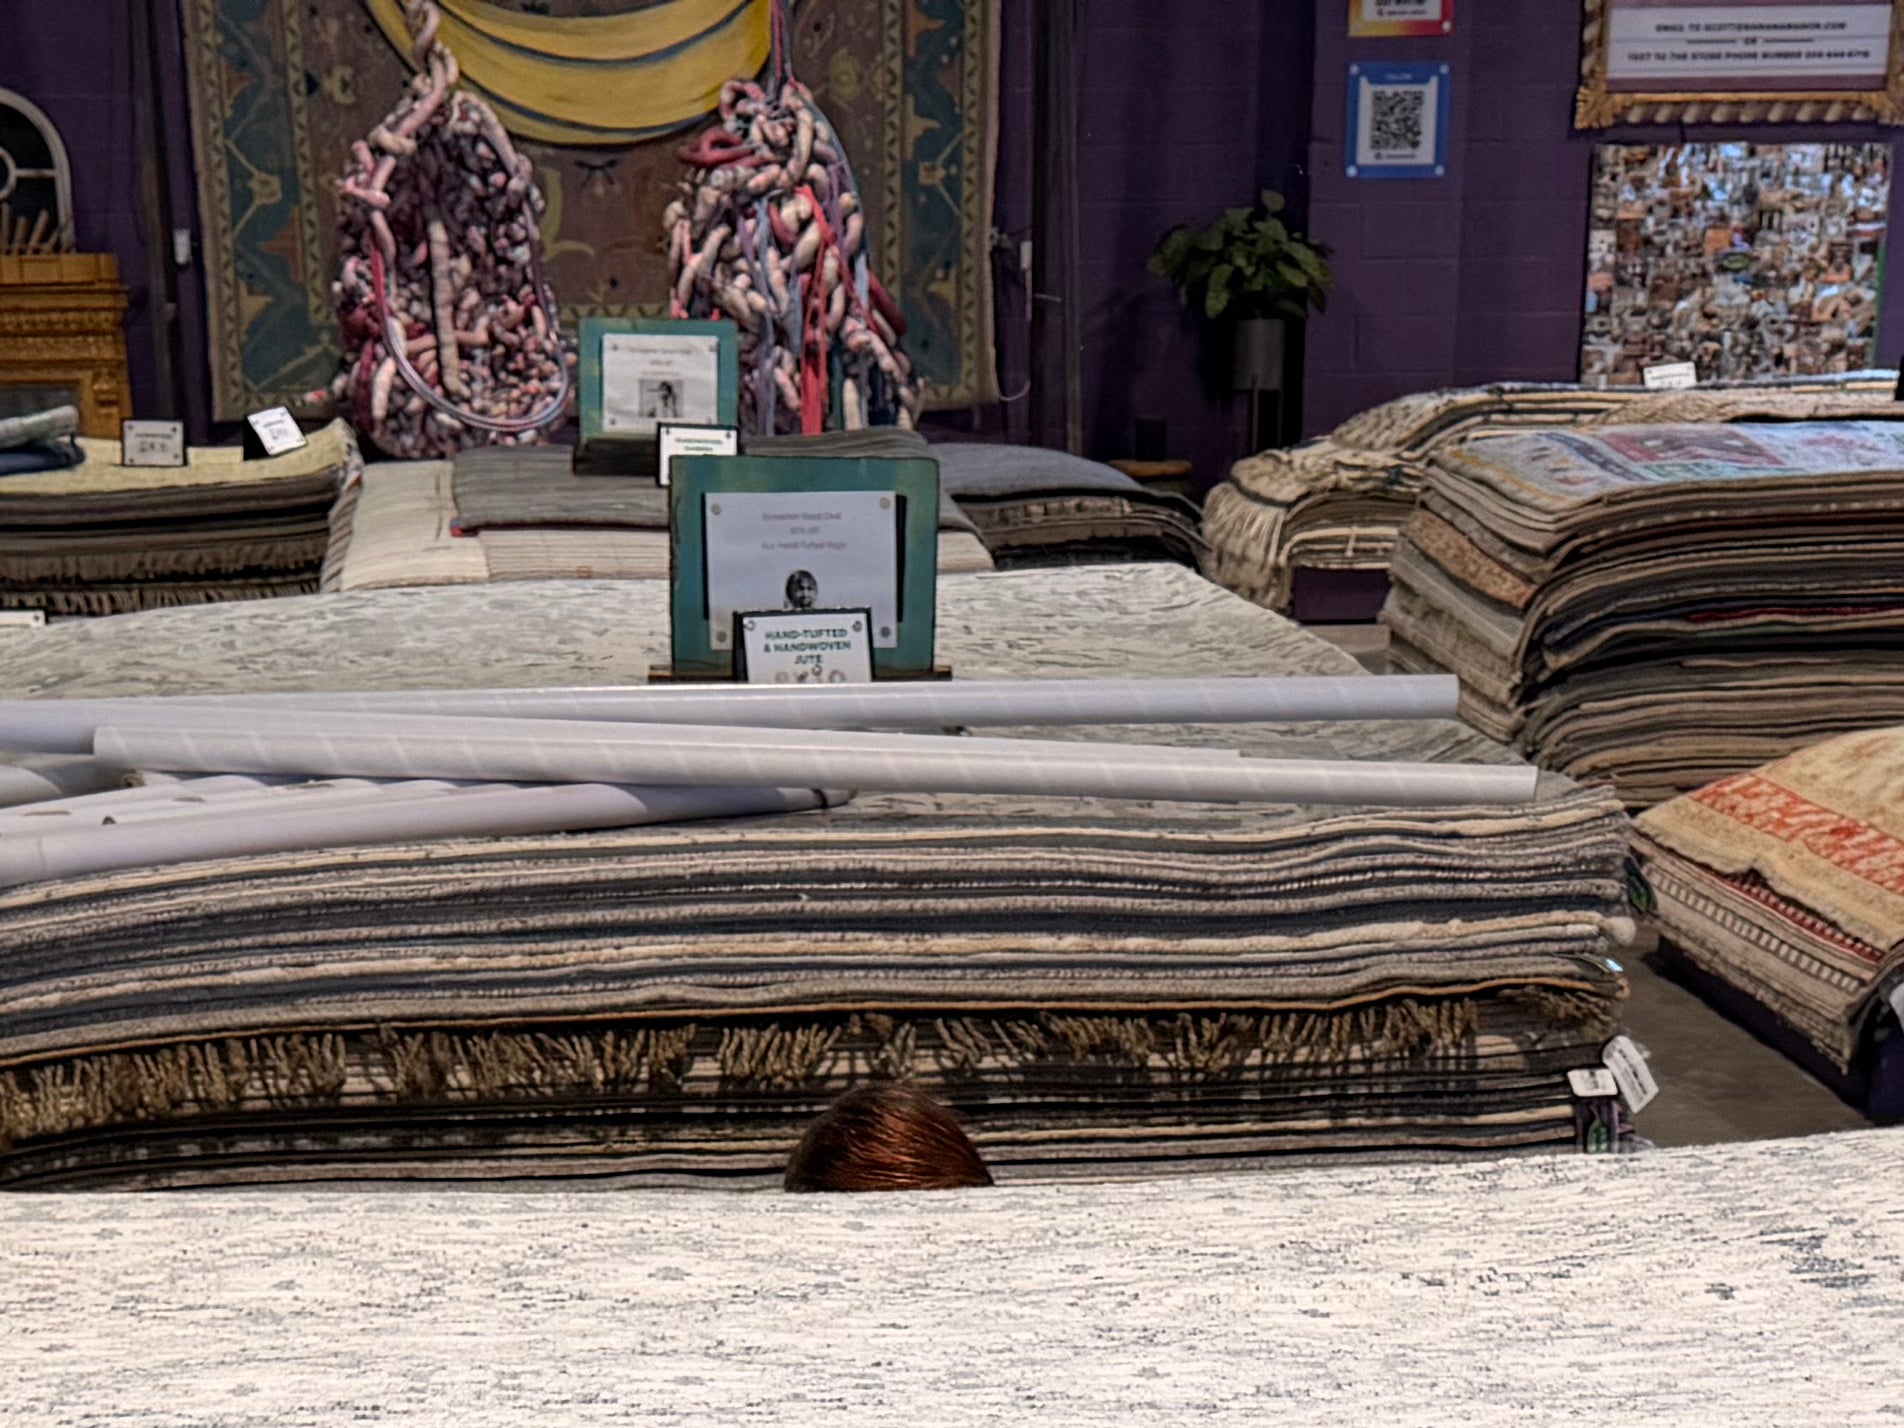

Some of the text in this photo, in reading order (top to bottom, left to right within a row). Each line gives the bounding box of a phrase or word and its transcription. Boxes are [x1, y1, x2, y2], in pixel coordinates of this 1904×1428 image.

[764, 628, 848, 640] HAND-TUFTED
[763, 640, 852, 653] & HANDWOVEN
[793, 654, 824, 665] JUTE
